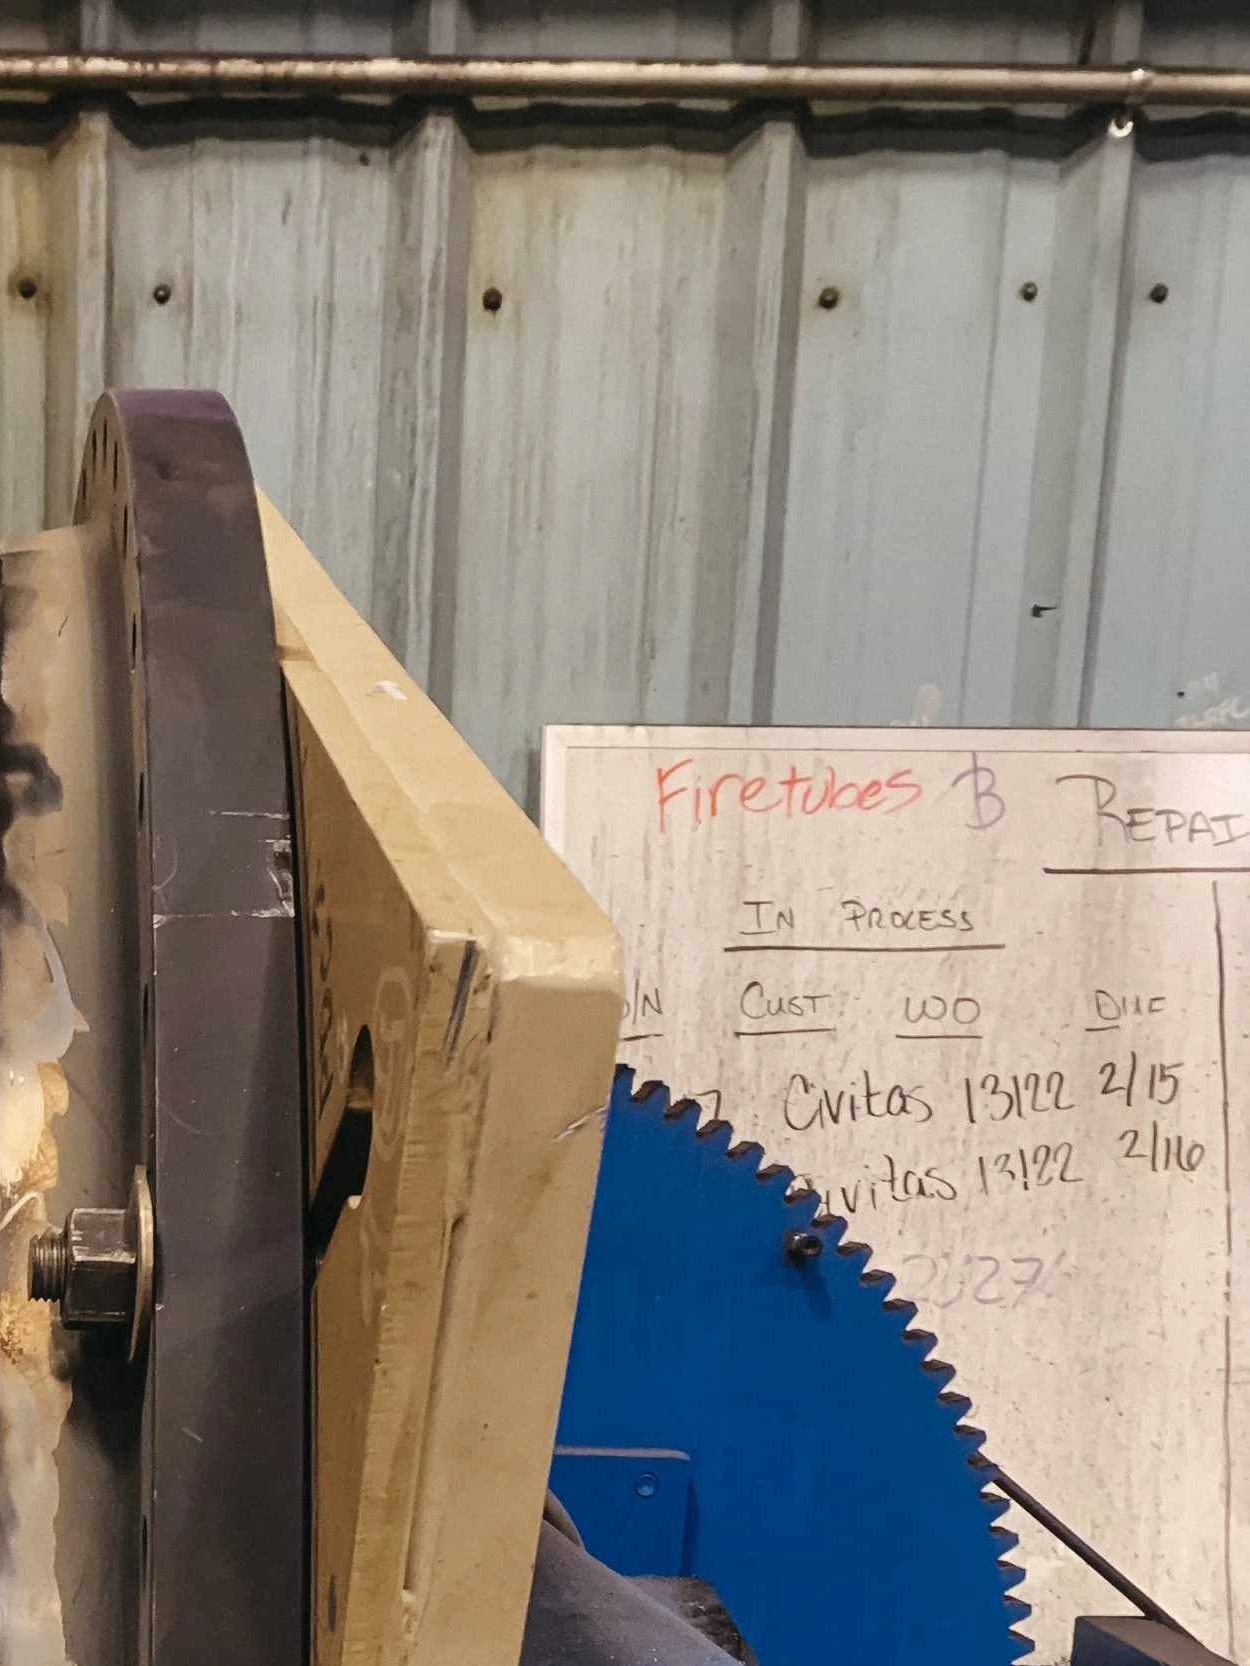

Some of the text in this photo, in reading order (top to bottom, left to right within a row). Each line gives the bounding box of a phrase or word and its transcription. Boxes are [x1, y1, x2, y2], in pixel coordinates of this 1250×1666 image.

[656, 758, 923, 834] Firetubes
[739, 899, 975, 936] IN PROCESS
[904, 994, 981, 1025] WO
[784, 1070, 934, 1131] Civitas
[1098, 1050, 1186, 1107] 2/15
[793, 1154, 958, 1217] ivitas
[1118, 1120, 1207, 1173] 2/16
